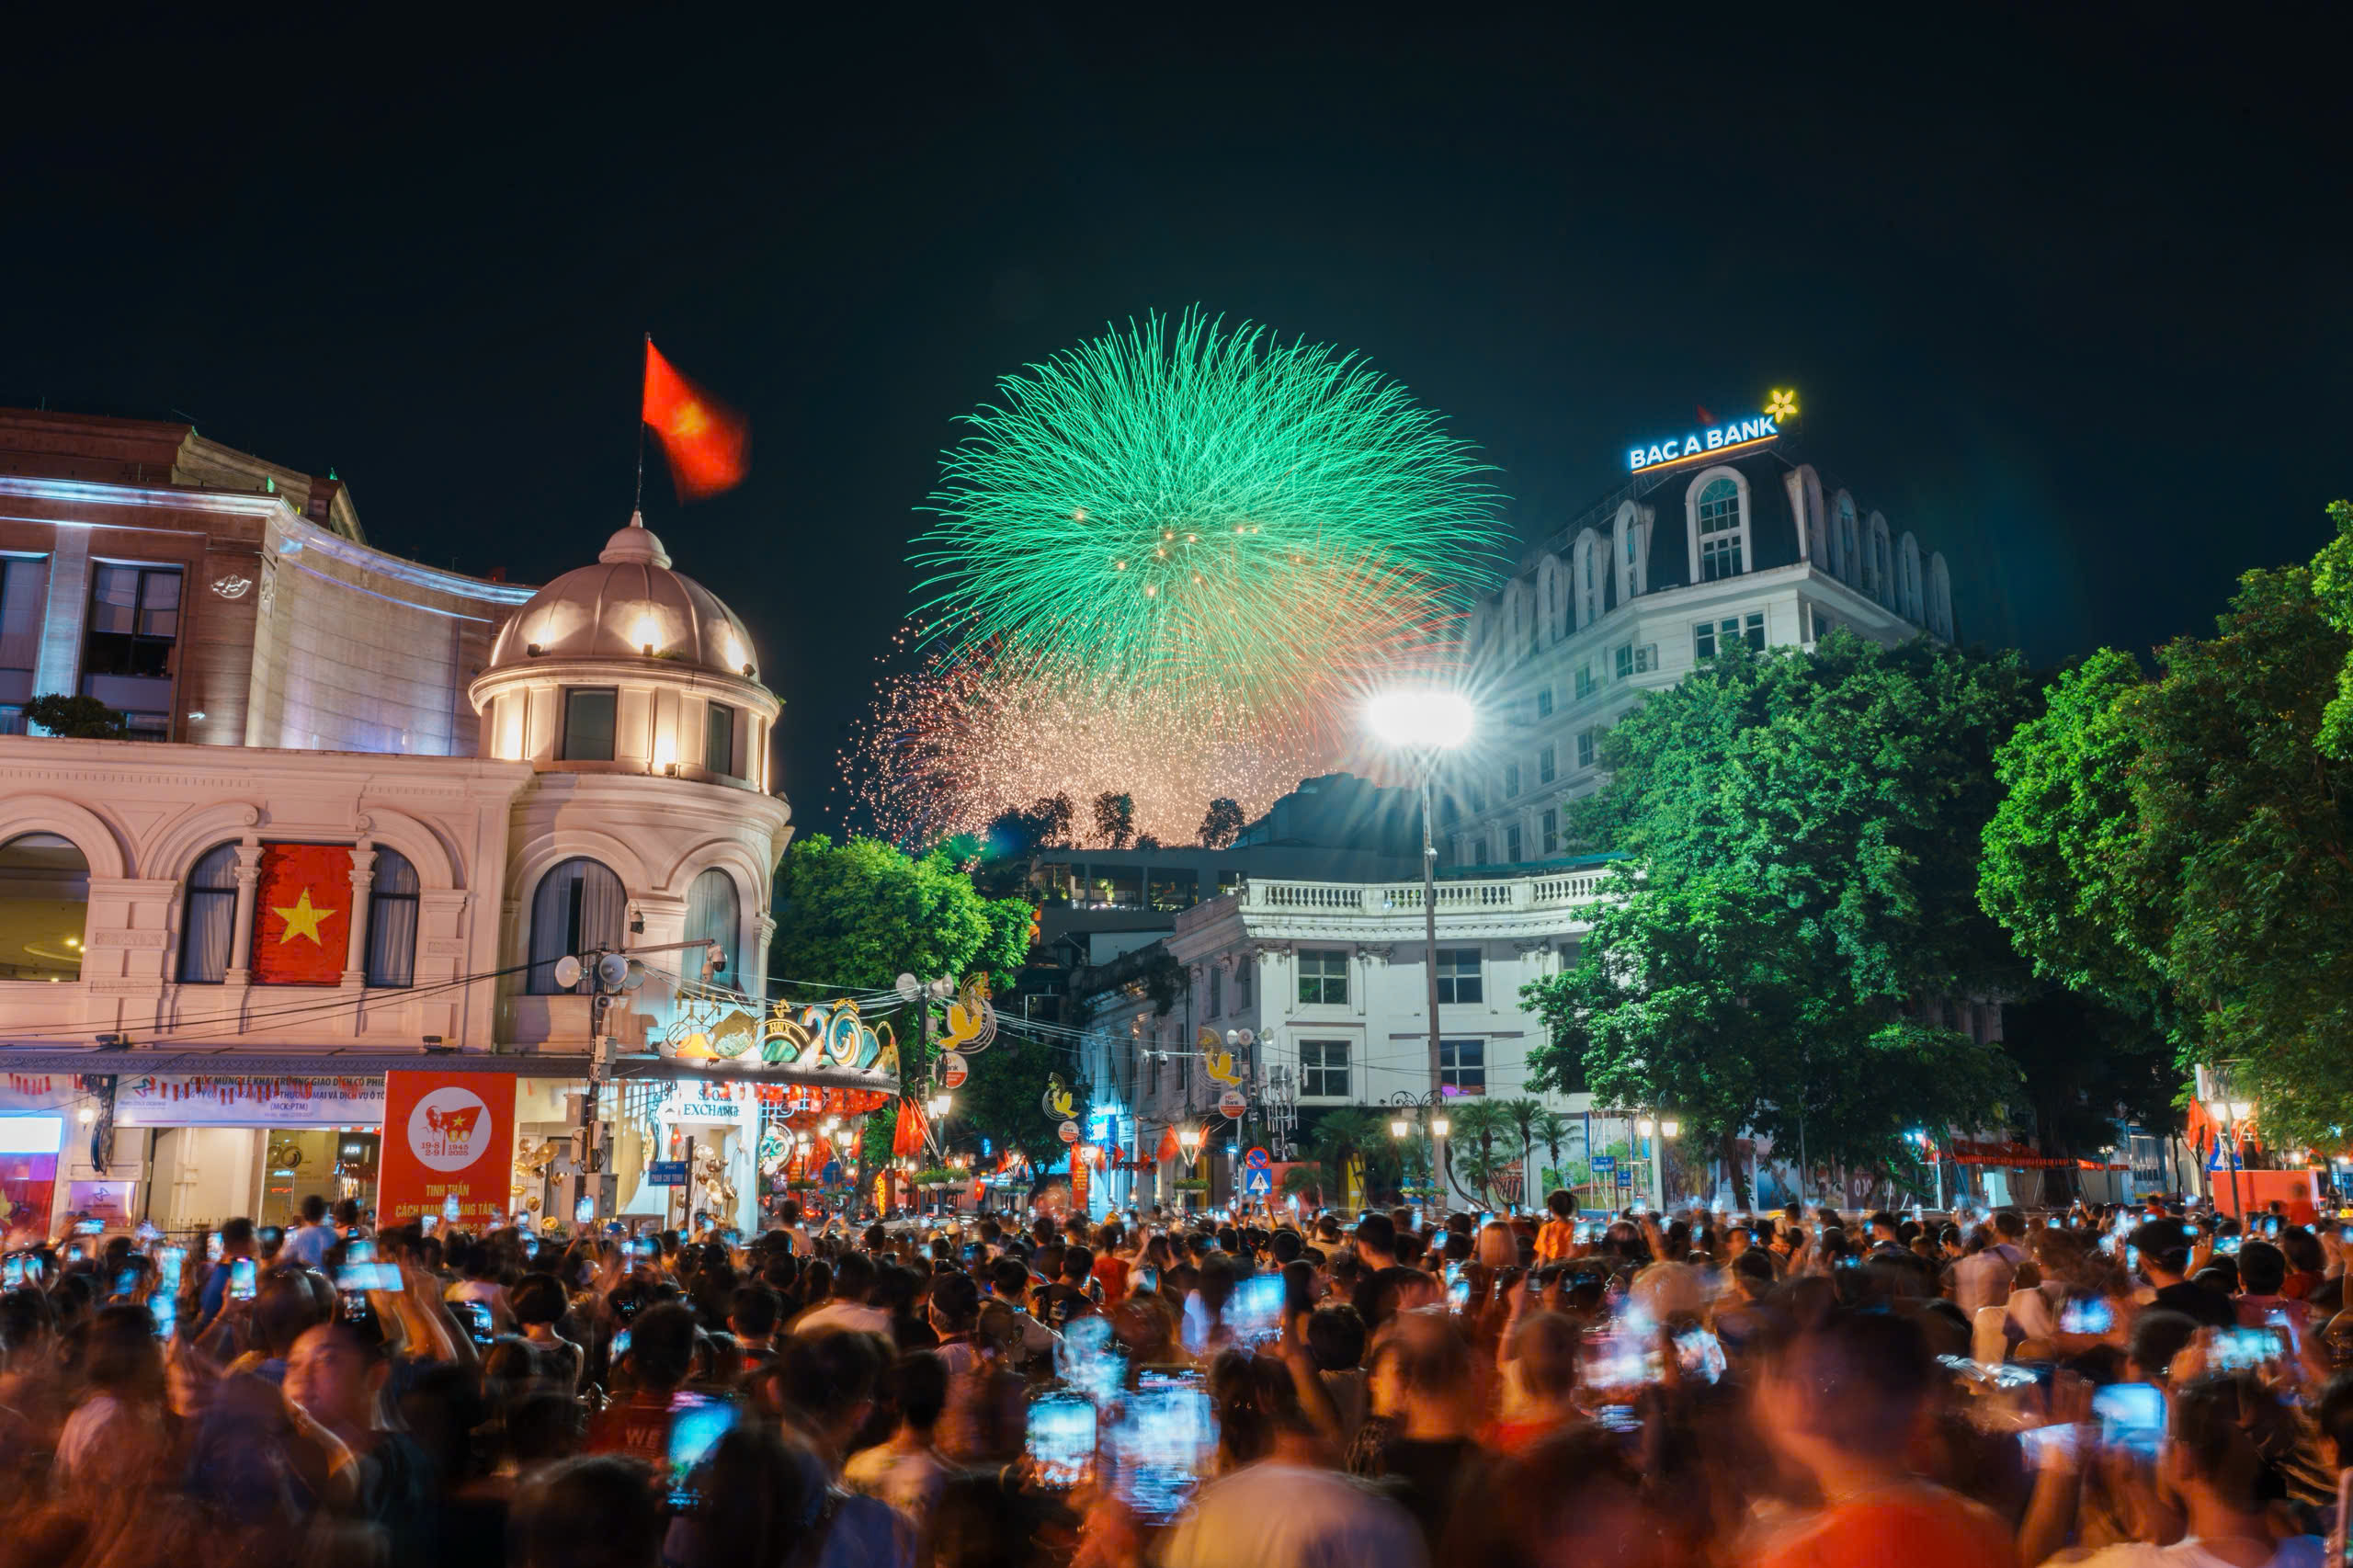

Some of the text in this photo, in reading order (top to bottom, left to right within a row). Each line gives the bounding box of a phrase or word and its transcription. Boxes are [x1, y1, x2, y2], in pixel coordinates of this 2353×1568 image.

[1631, 415, 1778, 469] BAC A BANK
[769, 1021, 791, 1035] HNX
[189, 1074, 213, 1085] CÚC
[253, 1076, 274, 1086] KHAI
[311, 1077, 331, 1087] GIAO
[366, 1075, 385, 1087] PHIẾ
[279, 1090, 312, 1100] THƯƠN
[313, 1091, 327, 1101] MẠI
[328, 1090, 337, 1100] VÀ
[270, 1103, 309, 1111] (MCK:PTM)
[684, 1103, 740, 1118] EXCHANGE
[426, 1184, 446, 1197] TINH
[395, 1201, 419, 1217] CÁCH
[421, 1204, 445, 1216] MẠN
